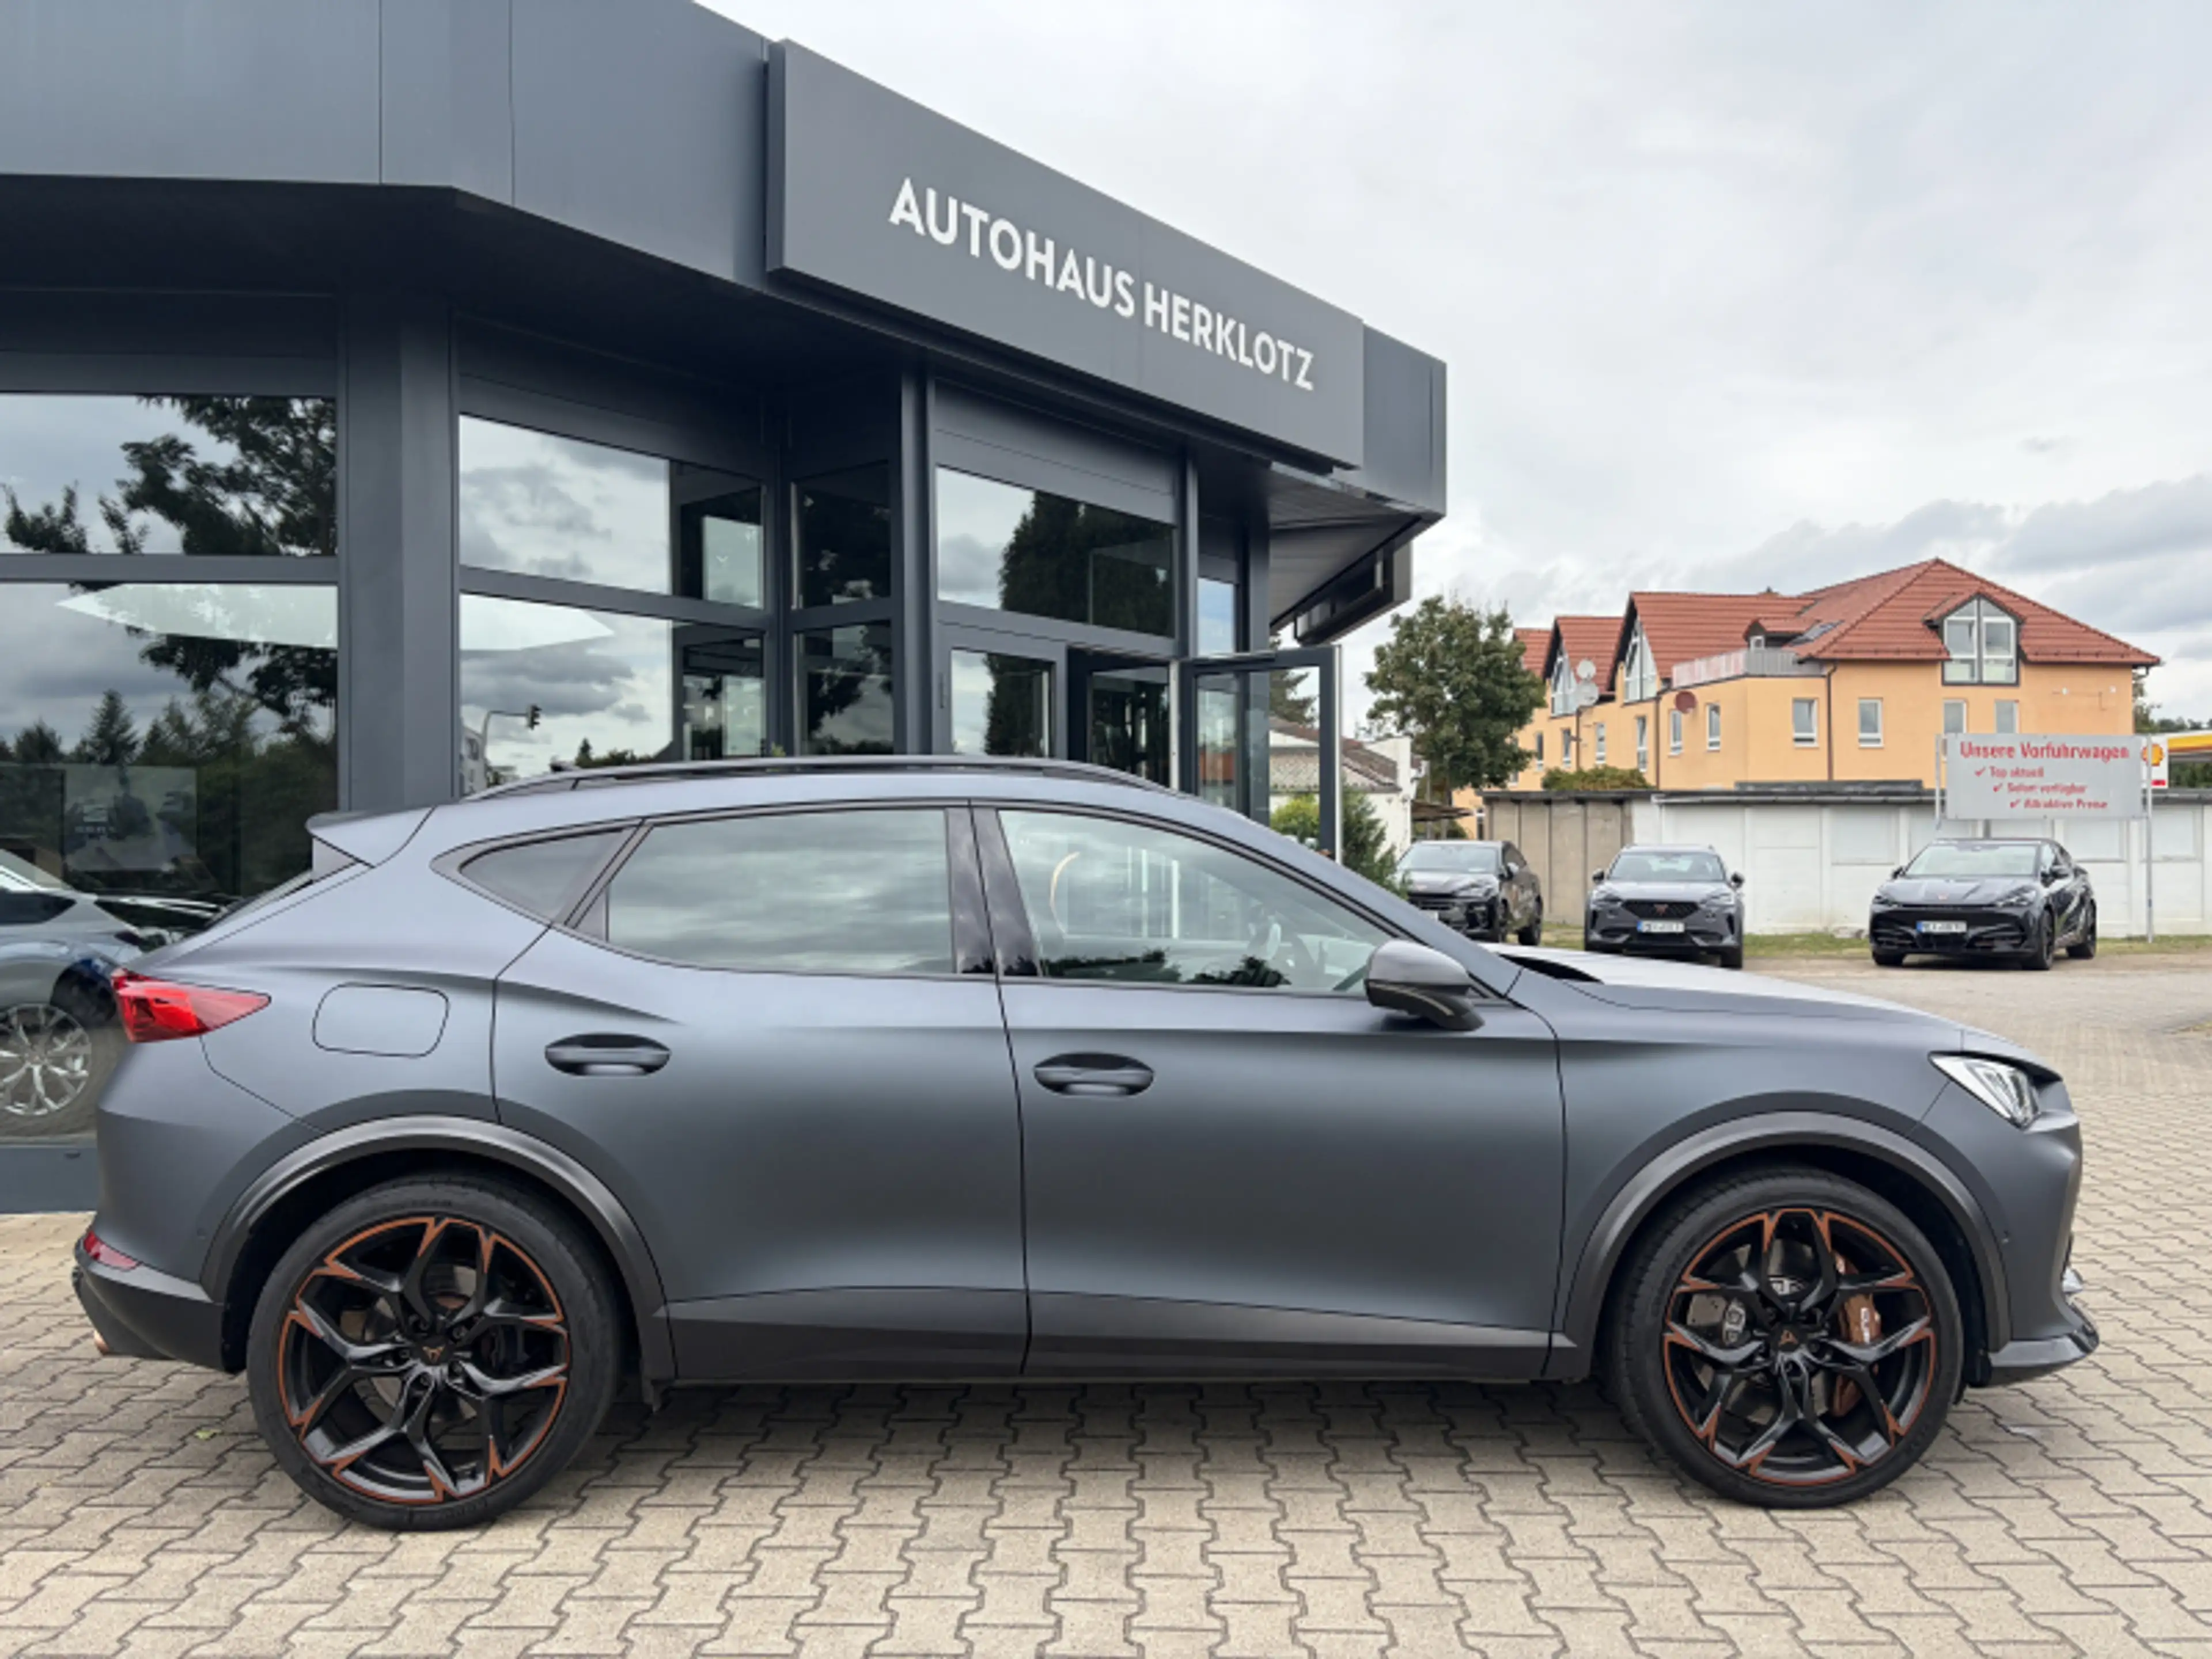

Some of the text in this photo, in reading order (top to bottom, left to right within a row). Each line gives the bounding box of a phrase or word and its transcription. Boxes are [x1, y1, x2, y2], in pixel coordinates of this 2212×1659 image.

[889, 177, 1314, 391] AUTOHAUS HERKLOTZ
[1960, 741, 2016, 759] Unsere
